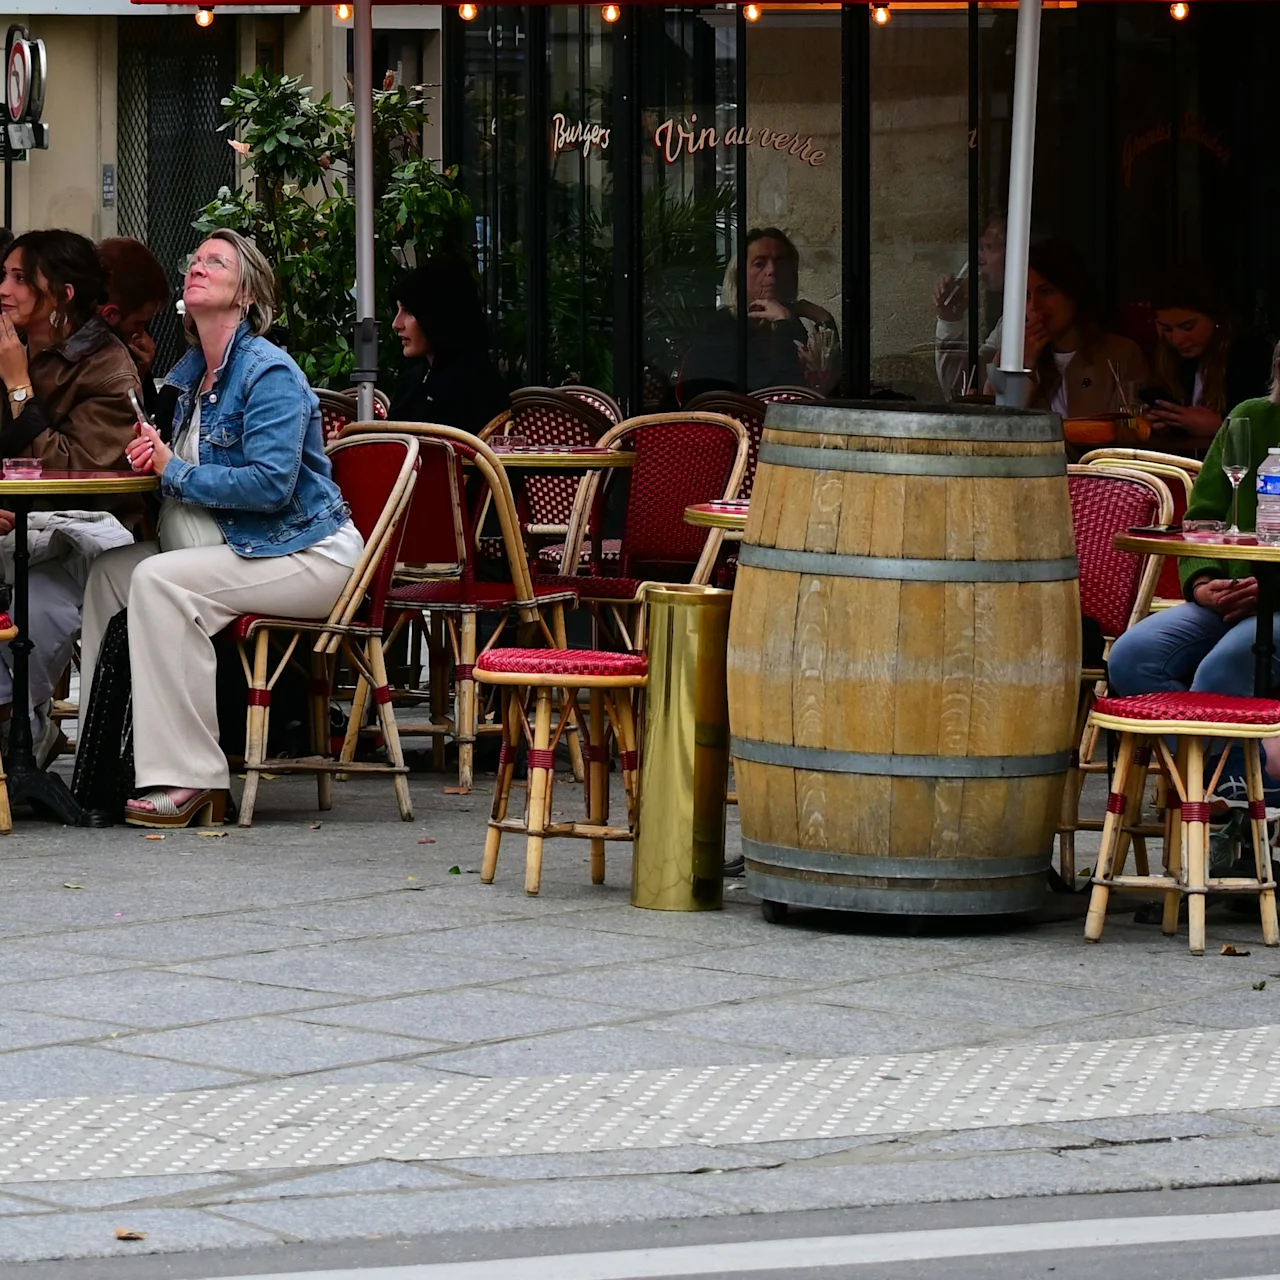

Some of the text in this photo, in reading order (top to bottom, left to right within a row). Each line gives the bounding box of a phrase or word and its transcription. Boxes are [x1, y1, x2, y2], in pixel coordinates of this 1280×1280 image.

[552, 113, 610, 157] Burgers
[655, 113, 827, 167] Vin au verre
